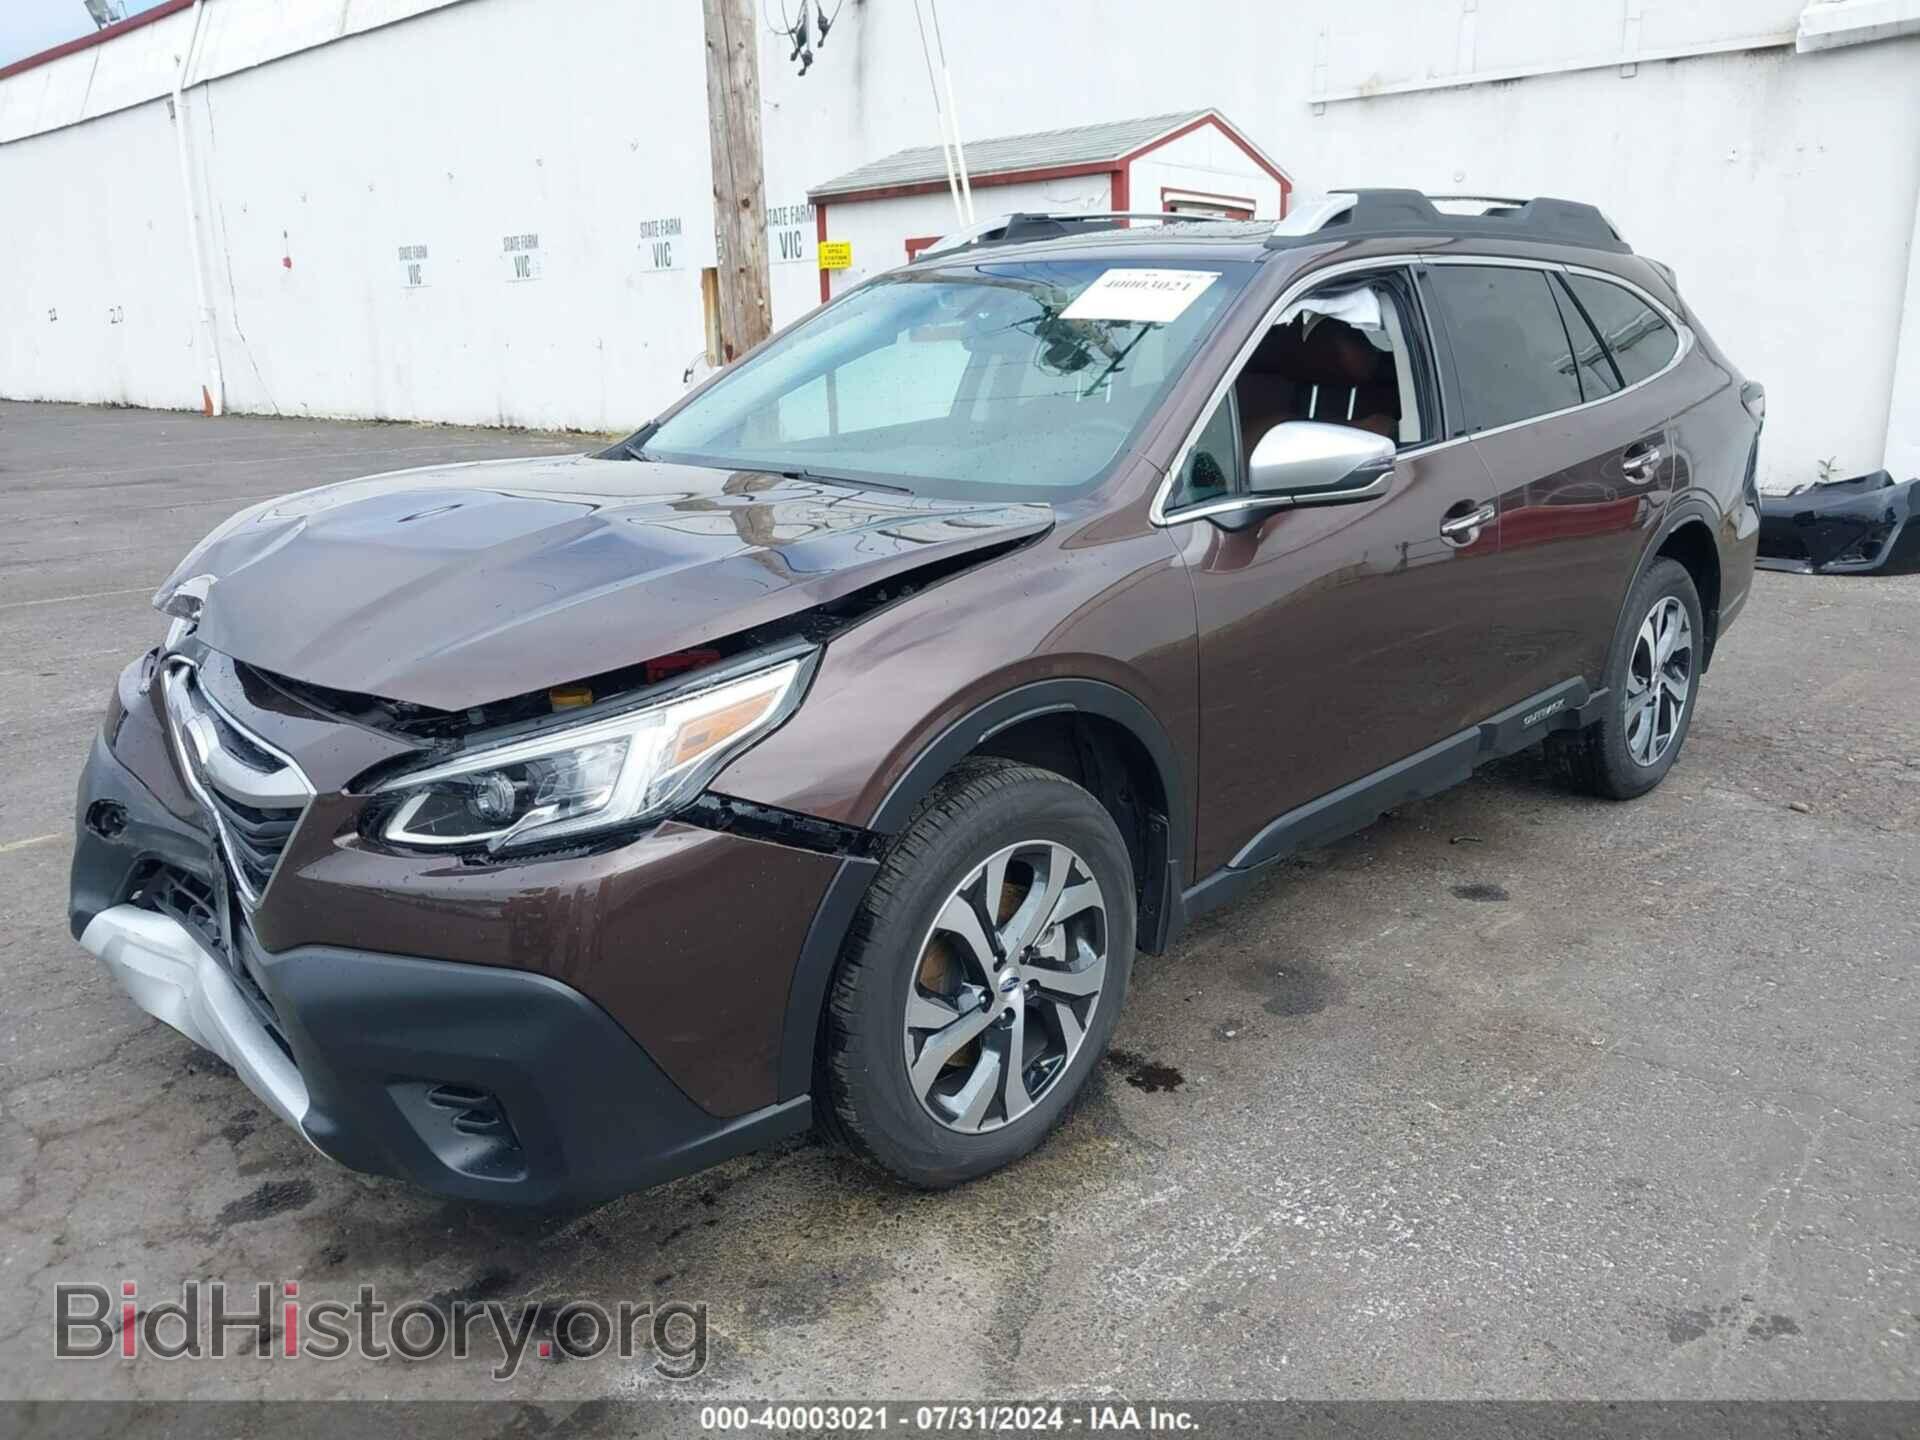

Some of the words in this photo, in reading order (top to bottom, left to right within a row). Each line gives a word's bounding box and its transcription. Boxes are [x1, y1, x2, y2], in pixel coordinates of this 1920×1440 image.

[767, 206, 788, 226] TATE
[790, 204, 816, 225] FARM
[640, 221, 660, 239] STATE
[660, 218, 682, 237] FARM
[503, 236, 520, 252] STATE
[520, 233, 539, 249] FARM
[779, 230, 802, 259] VIC
[652, 241, 672, 268] VIC
[407, 263, 422, 285] VIC
[514, 254, 531, 278] VIC
